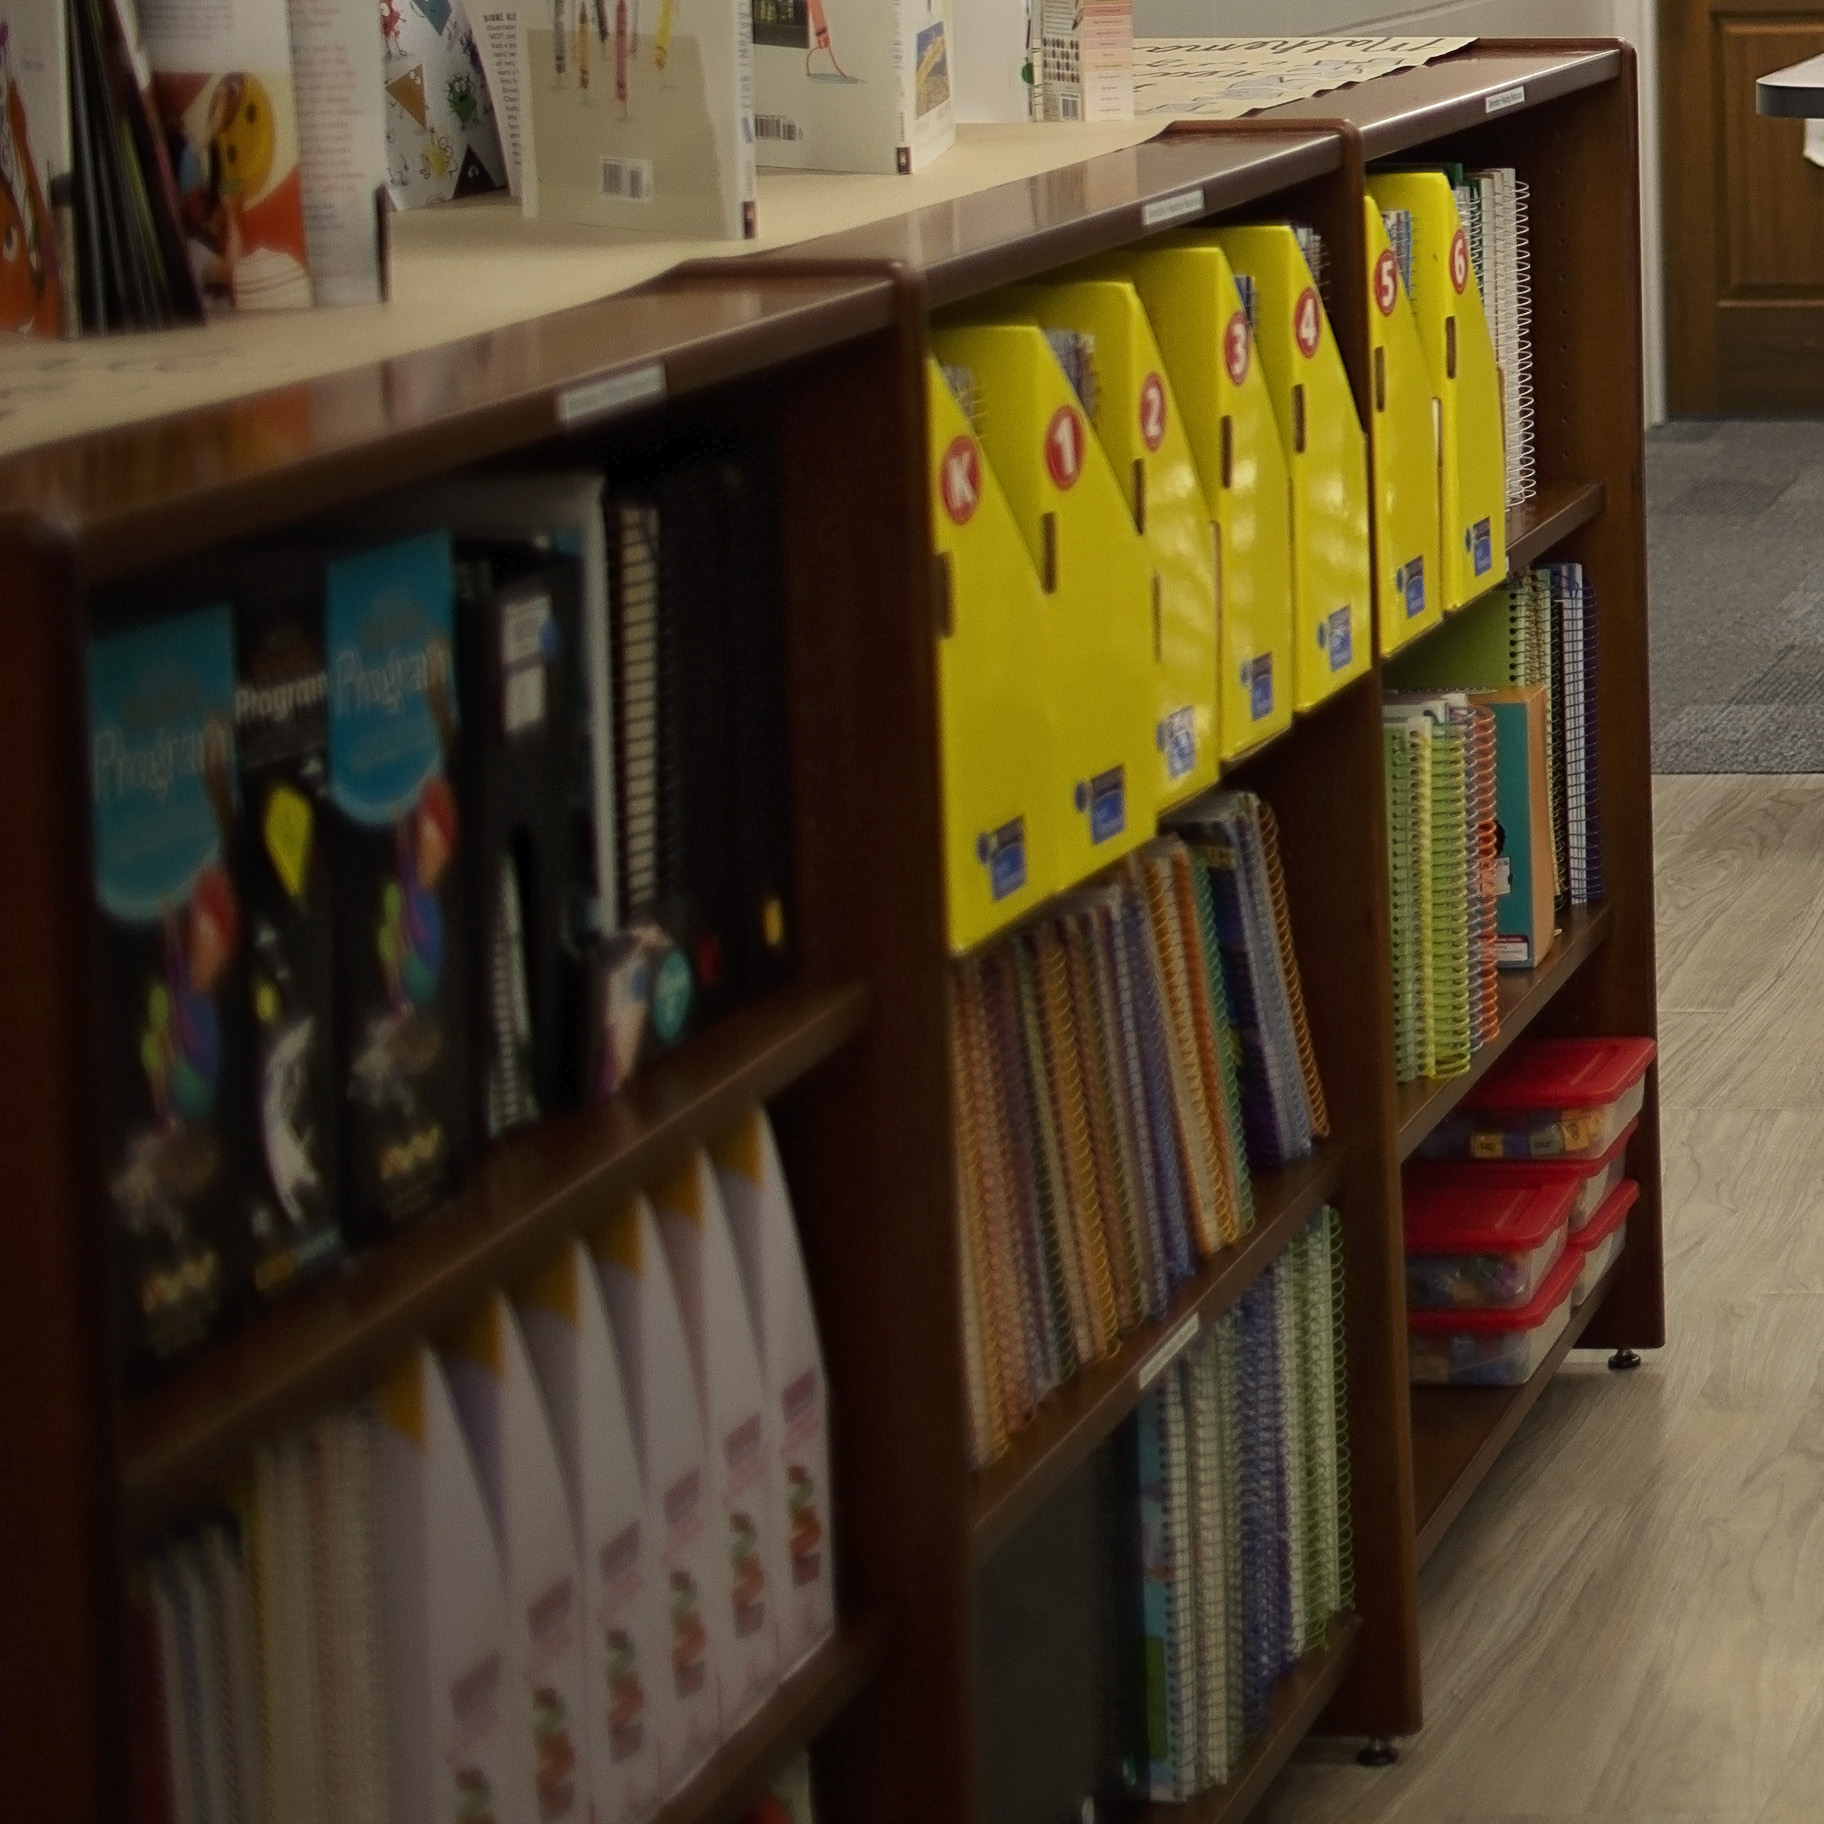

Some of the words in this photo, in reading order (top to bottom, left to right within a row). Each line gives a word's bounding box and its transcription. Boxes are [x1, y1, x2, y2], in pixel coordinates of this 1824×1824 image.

[1133, 37, 1446, 53] Mathema
[1452, 242, 1467, 280] 6
[1378, 264, 1396, 303] 5
[1299, 300, 1318, 343] 4
[1229, 328, 1247, 372] 3
[1144, 392, 1162, 432] 2
[1055, 422, 1075, 469] 1
[947, 453, 975, 504] K
